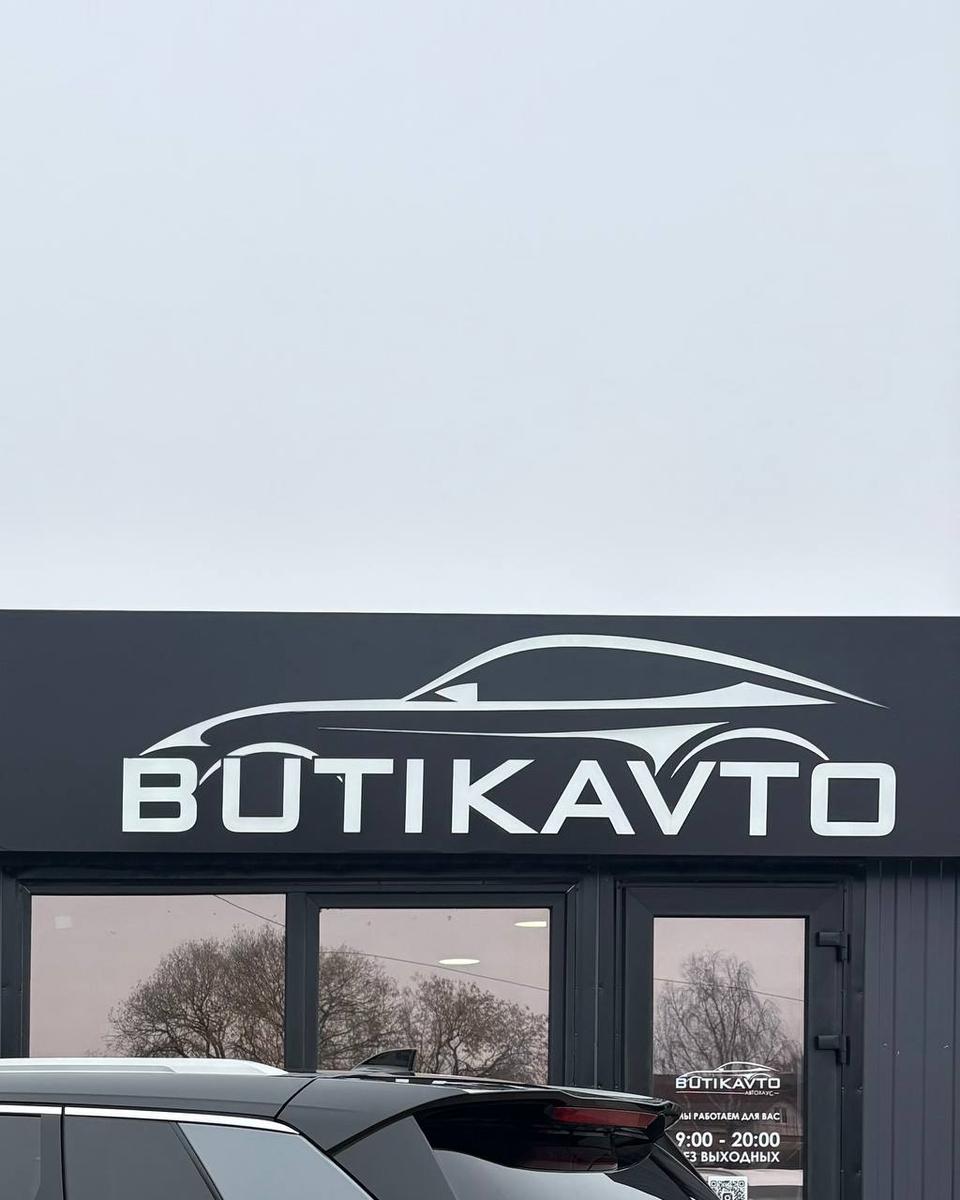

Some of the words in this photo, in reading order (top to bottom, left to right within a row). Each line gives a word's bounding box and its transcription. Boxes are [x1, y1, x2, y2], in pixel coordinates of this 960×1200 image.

[121, 757, 897, 837] BUTIKAVTO
[675, 1077, 780, 1090] BUTIKAVTO
[693, 1112, 740, 1121] РАБОТАЕМ
[741, 1112, 760, 1121] ДЛЯ
[762, 1112, 781, 1121] ВАС
[675, 1131, 713, 1148] 9:00
[731, 1131, 781, 1148] 20:00
[701, 1151, 780, 1164] ВЫХОДНЫХ
